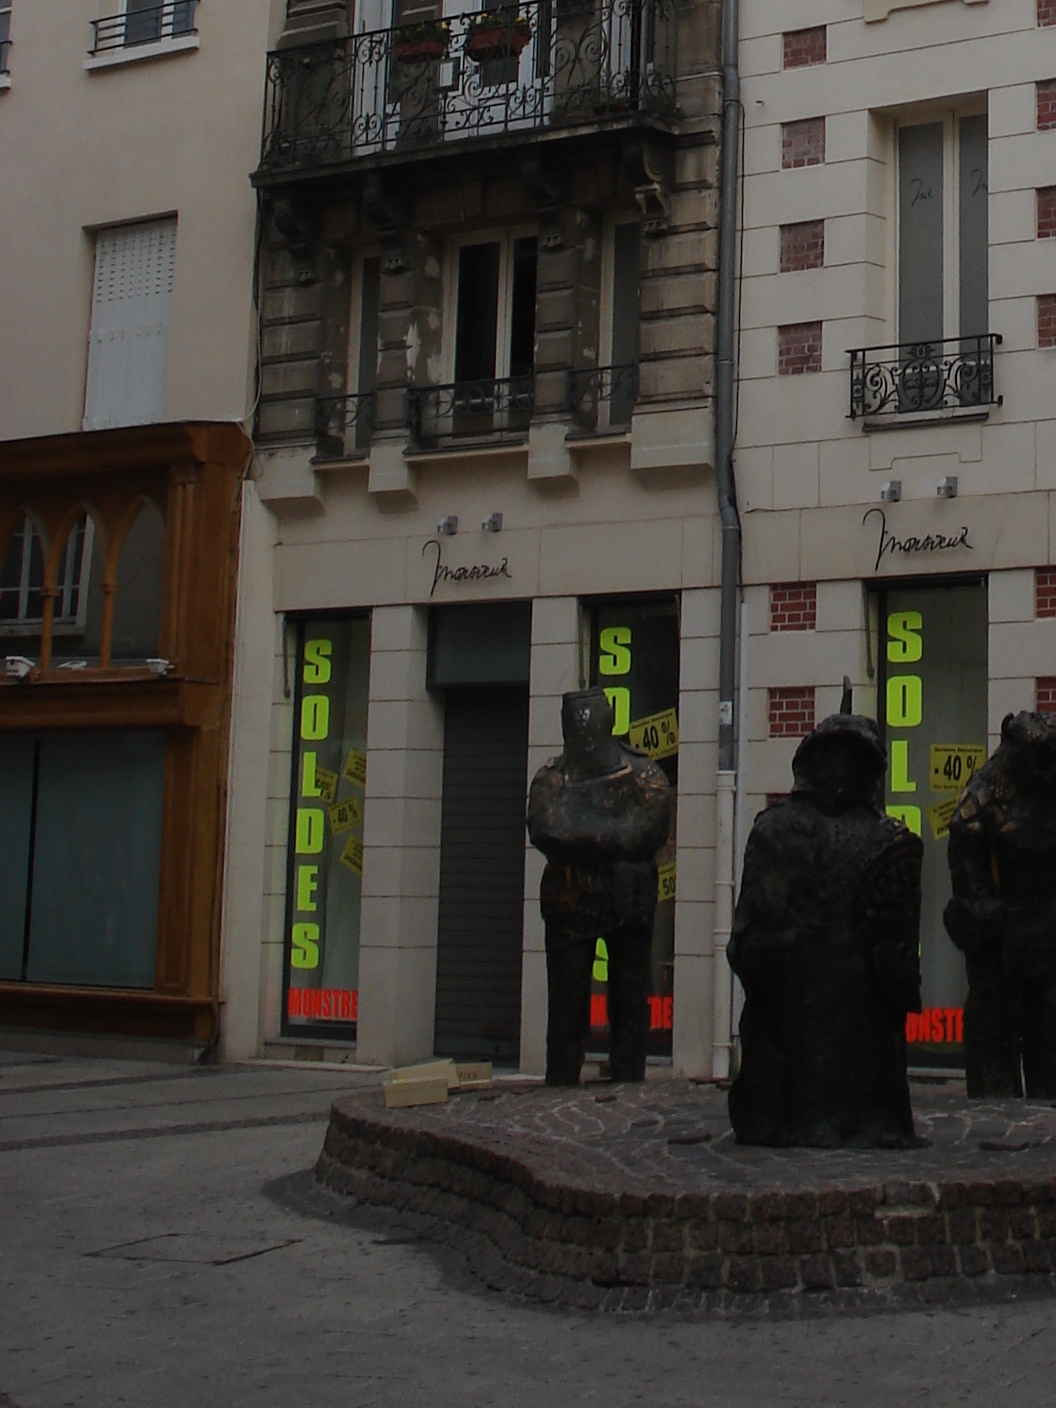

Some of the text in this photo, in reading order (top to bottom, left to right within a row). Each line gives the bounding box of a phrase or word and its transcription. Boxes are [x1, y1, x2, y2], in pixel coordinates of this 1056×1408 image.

[642, 725, 659, 751] 40
[943, 754, 962, 782] 40
[290, 638, 333, 970] SOLDES
[287, 987, 359, 1021] MONSTRE
